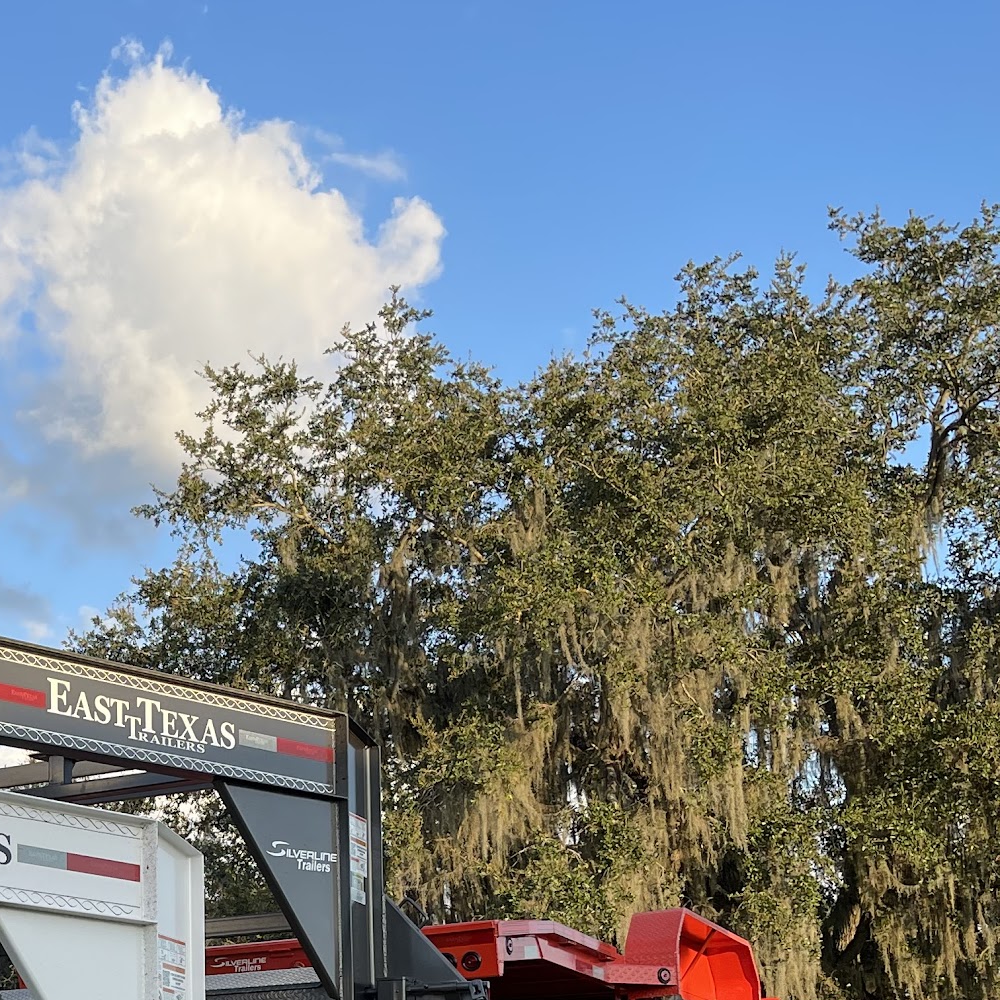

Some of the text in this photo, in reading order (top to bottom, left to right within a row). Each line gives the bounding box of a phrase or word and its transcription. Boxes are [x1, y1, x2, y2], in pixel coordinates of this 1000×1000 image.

[47, 677, 236, 750] EAST TEXAS
[125, 715, 206, 754] TRAILERS
[266, 840, 338, 863] SILVERLINE
[297, 859, 331, 873] Trailers
[210, 957, 267, 968] SILVERLINE
[234, 964, 262, 973] Trailers
